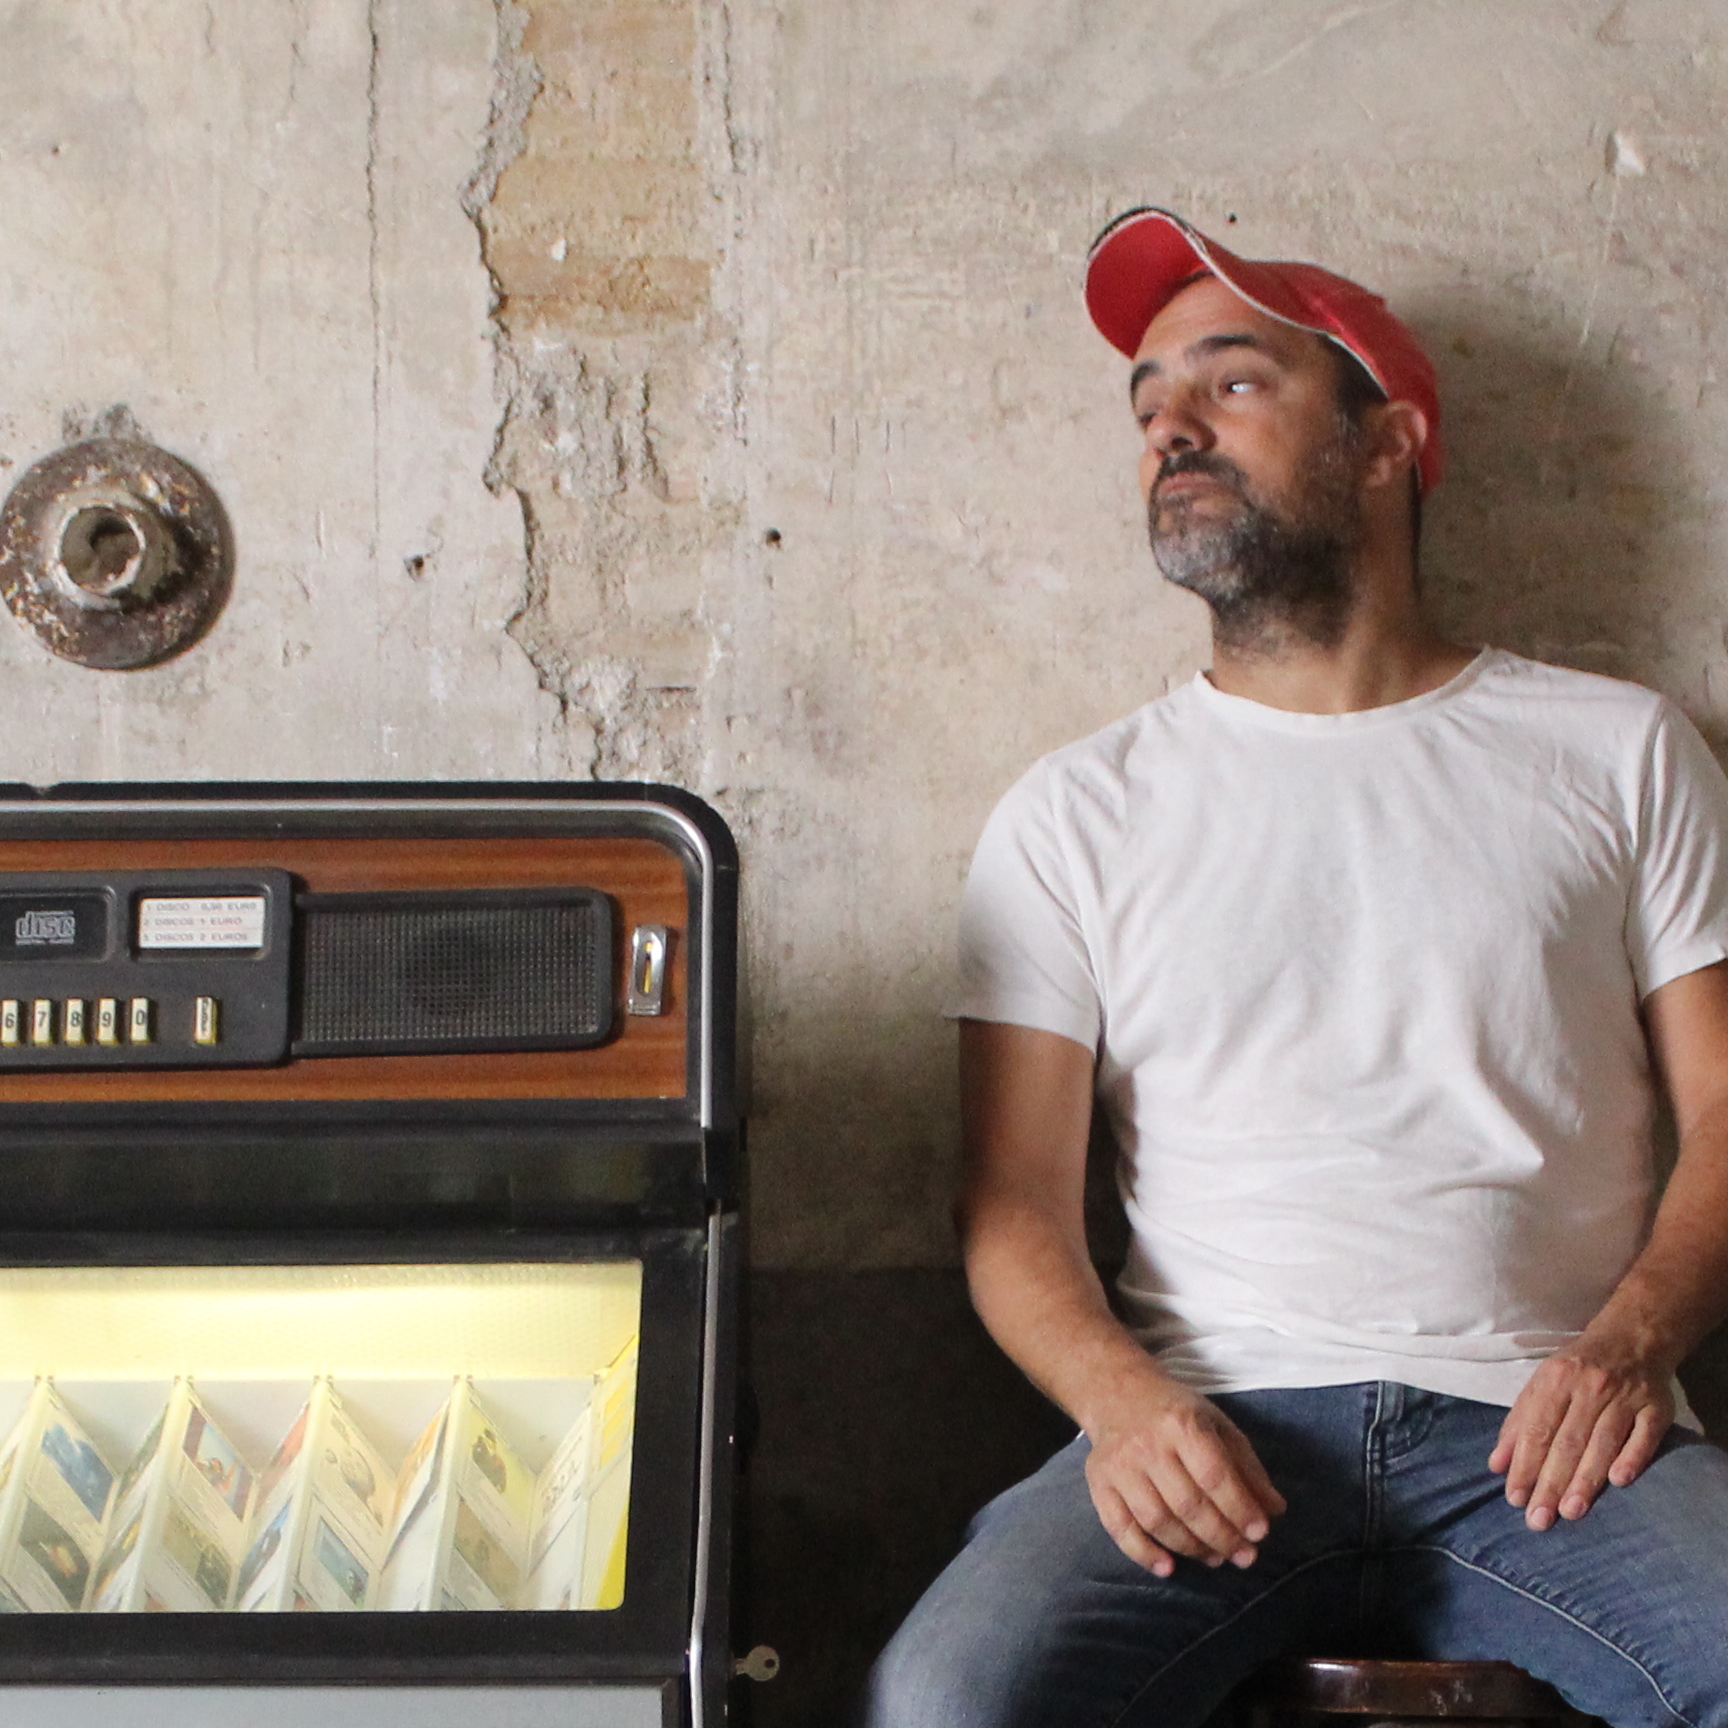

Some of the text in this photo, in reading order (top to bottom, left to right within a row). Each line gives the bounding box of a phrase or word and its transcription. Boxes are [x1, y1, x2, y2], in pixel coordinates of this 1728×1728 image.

[156, 903, 190, 911] DISCO
[227, 903, 257, 911] EURO
[155, 918, 195, 926] DISCOS
[211, 917, 242, 925] EURO
[155, 932, 194, 941] DISCOS
[212, 932, 248, 941] EUROS
[4, 1012, 15, 1029] 6
[37, 1011, 48, 1028] 7
[71, 1011, 82, 1028] 8
[101, 1011, 112, 1028] 9
[135, 1009, 146, 1026] 0
